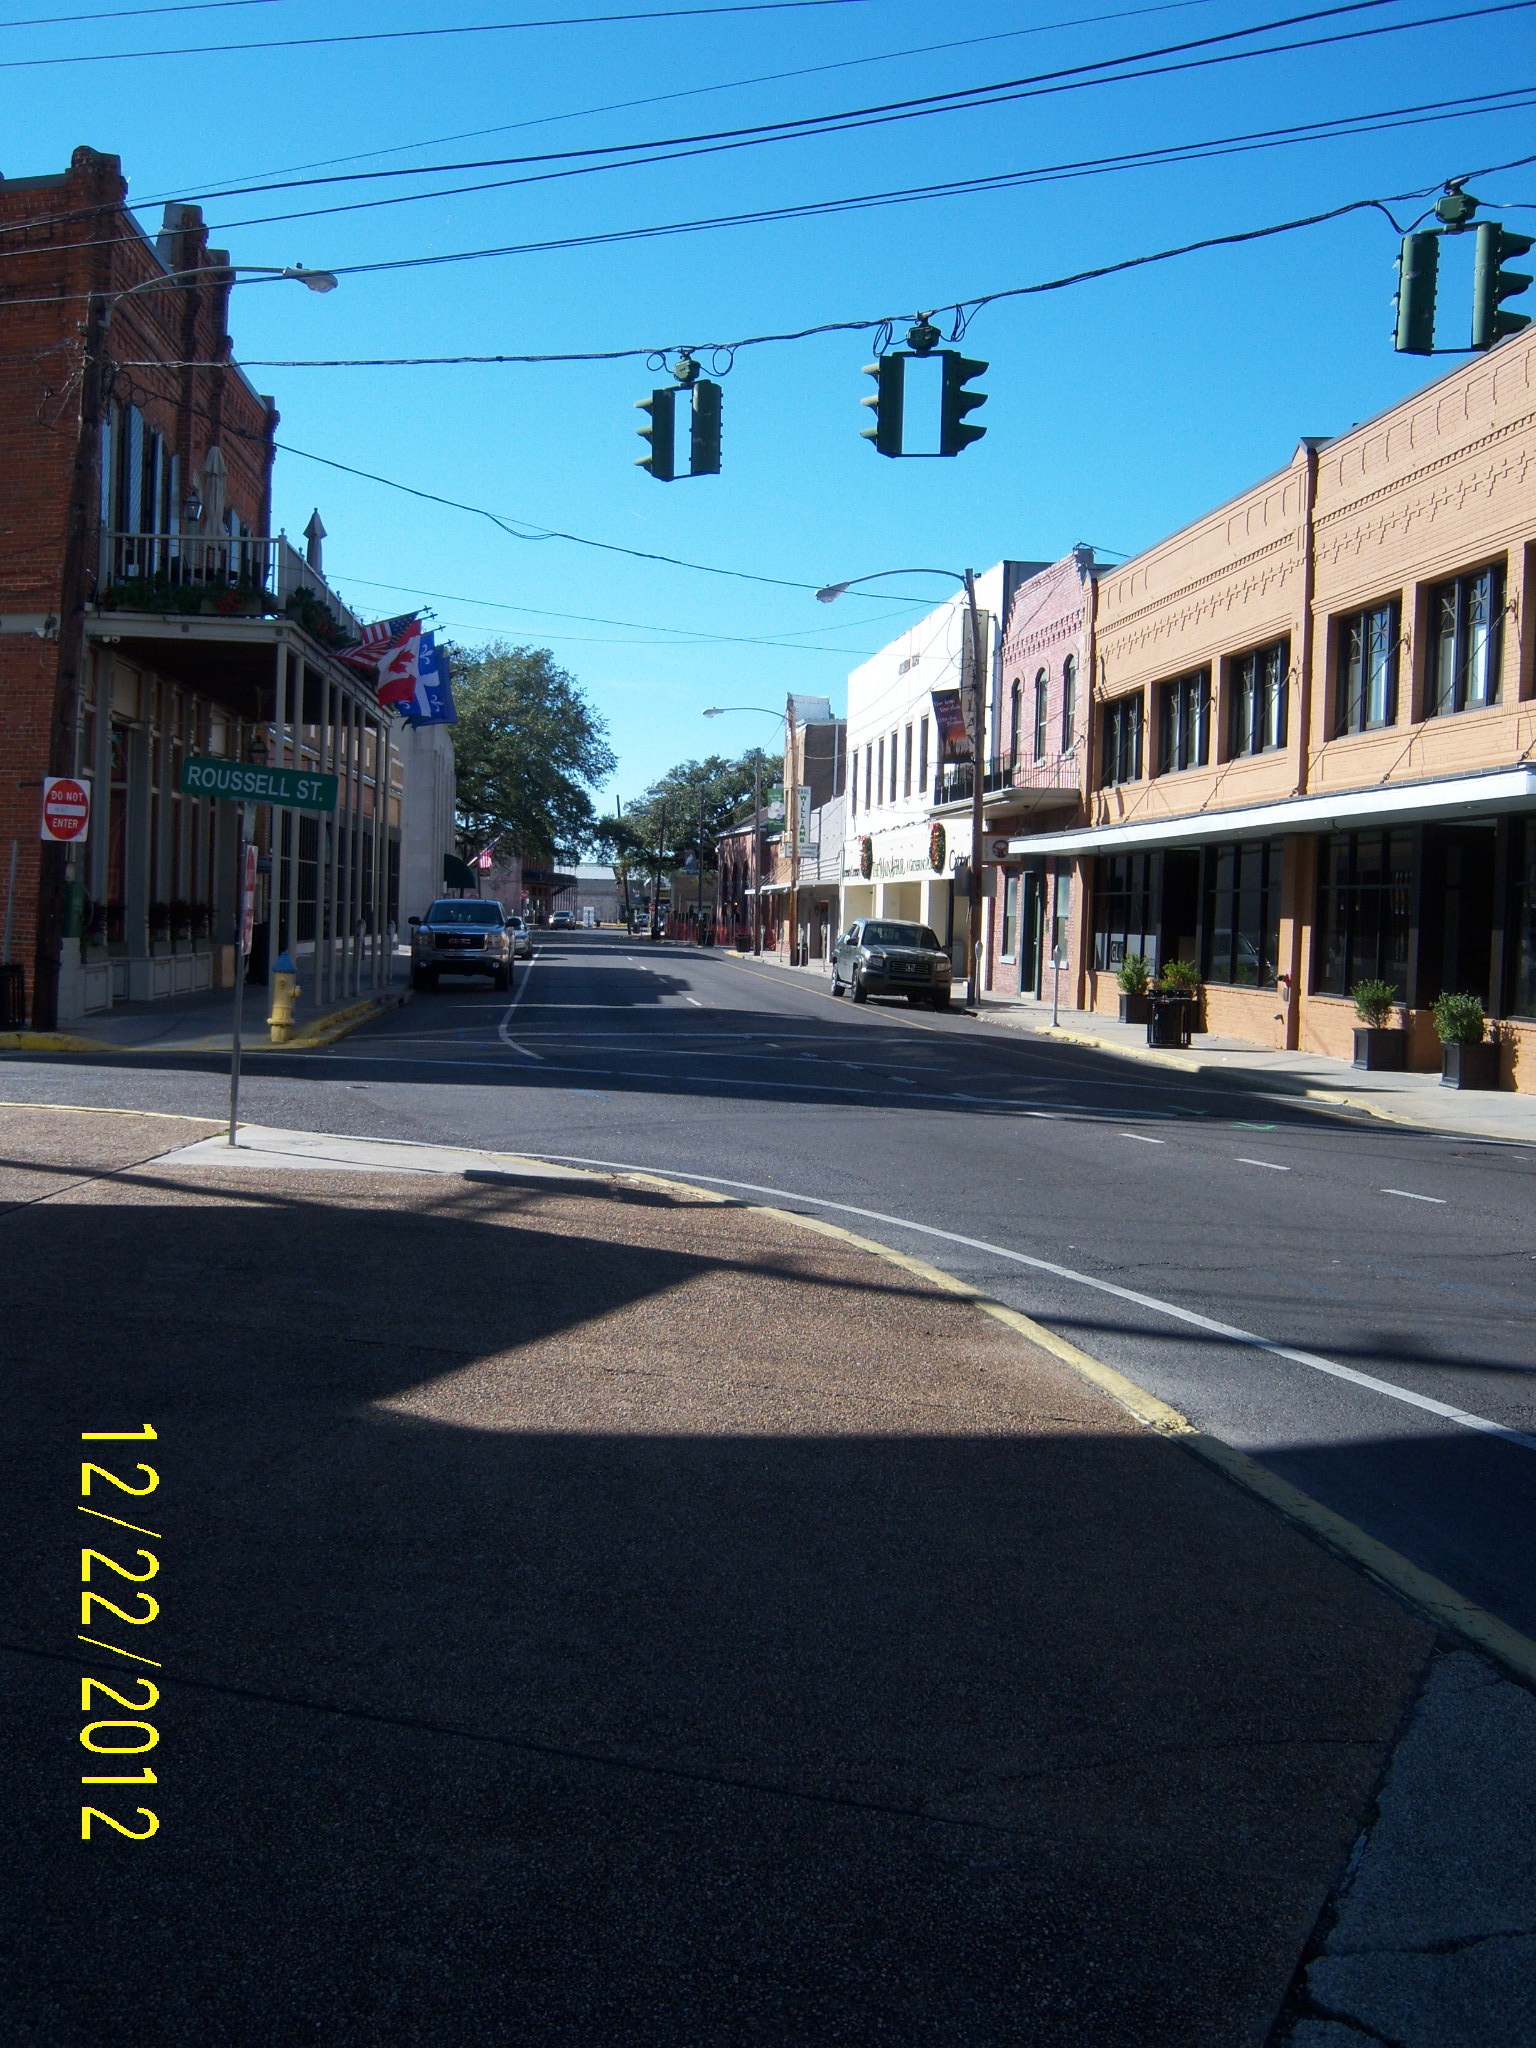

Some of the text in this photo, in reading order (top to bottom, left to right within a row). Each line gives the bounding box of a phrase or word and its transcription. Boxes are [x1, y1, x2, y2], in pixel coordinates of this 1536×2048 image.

[187, 765, 323, 802] ROUSSELL ST.
[51, 790, 84, 802] DO NOT
[52, 818, 78, 829] ENTER
[799, 795, 807, 843] WILLIAMS
